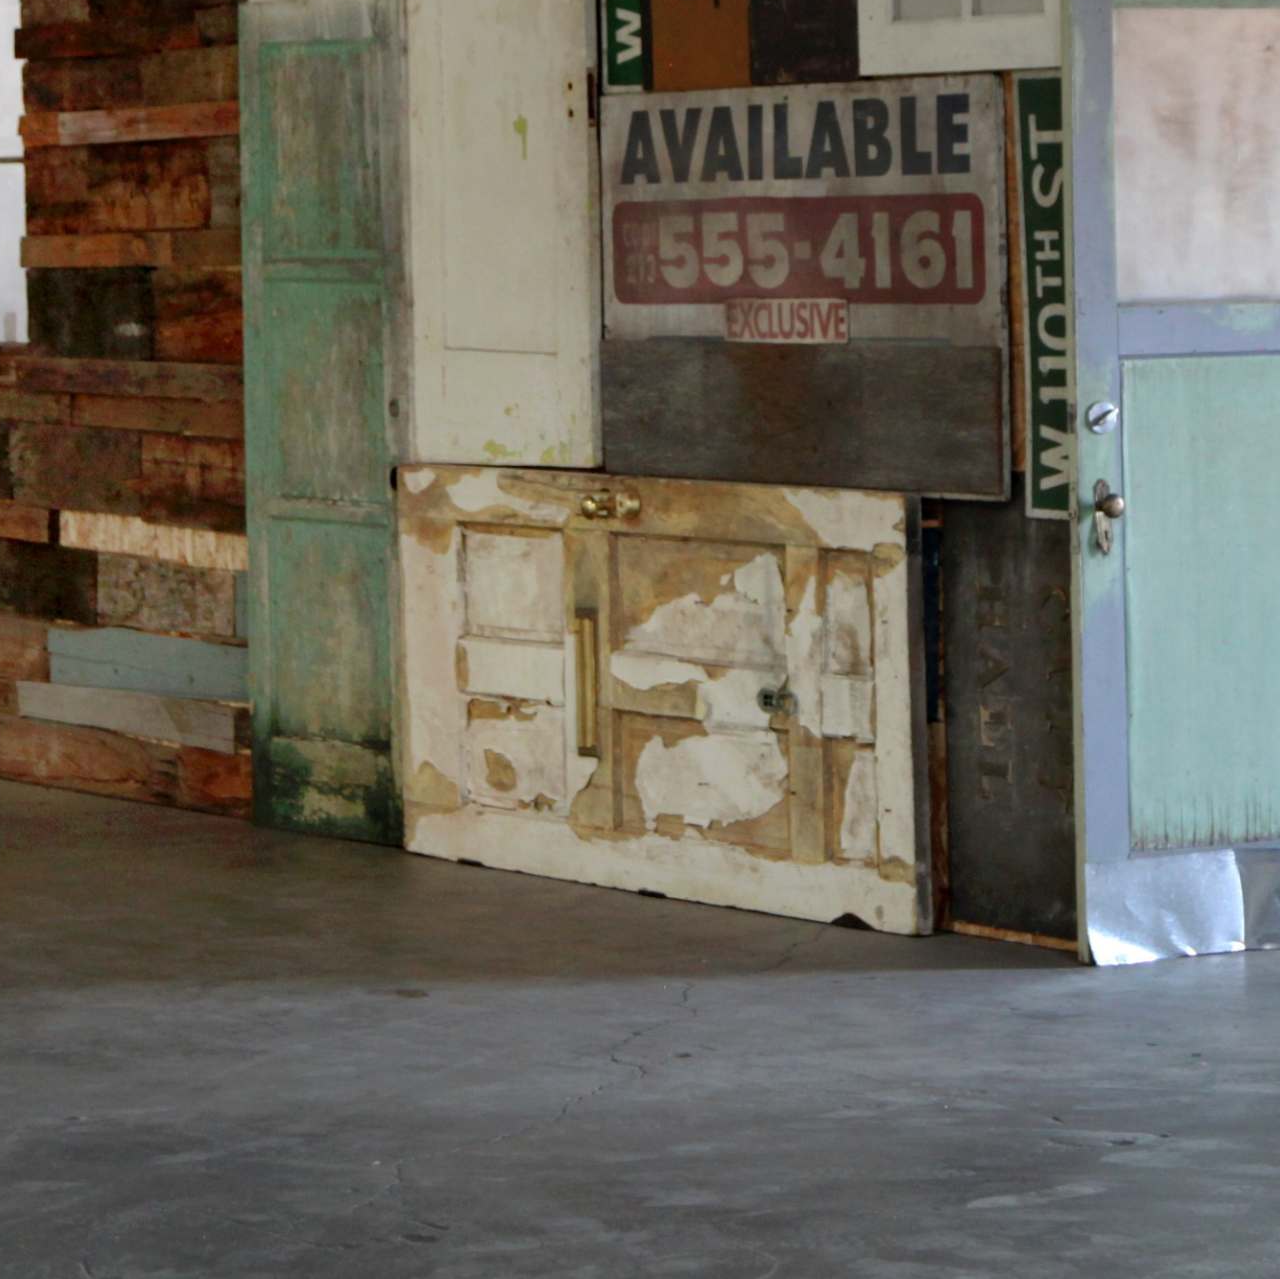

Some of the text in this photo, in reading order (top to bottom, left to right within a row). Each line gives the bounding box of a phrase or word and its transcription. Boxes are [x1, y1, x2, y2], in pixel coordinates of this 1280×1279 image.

[616, 7, 642, 64] W
[621, 93, 972, 186] AVAILABLE
[1028, 113, 1065, 205] ST
[657, 209, 975, 290] 555-4161
[727, 300, 847, 341] EXCLUSIVE
[1040, 425, 1075, 491] W
